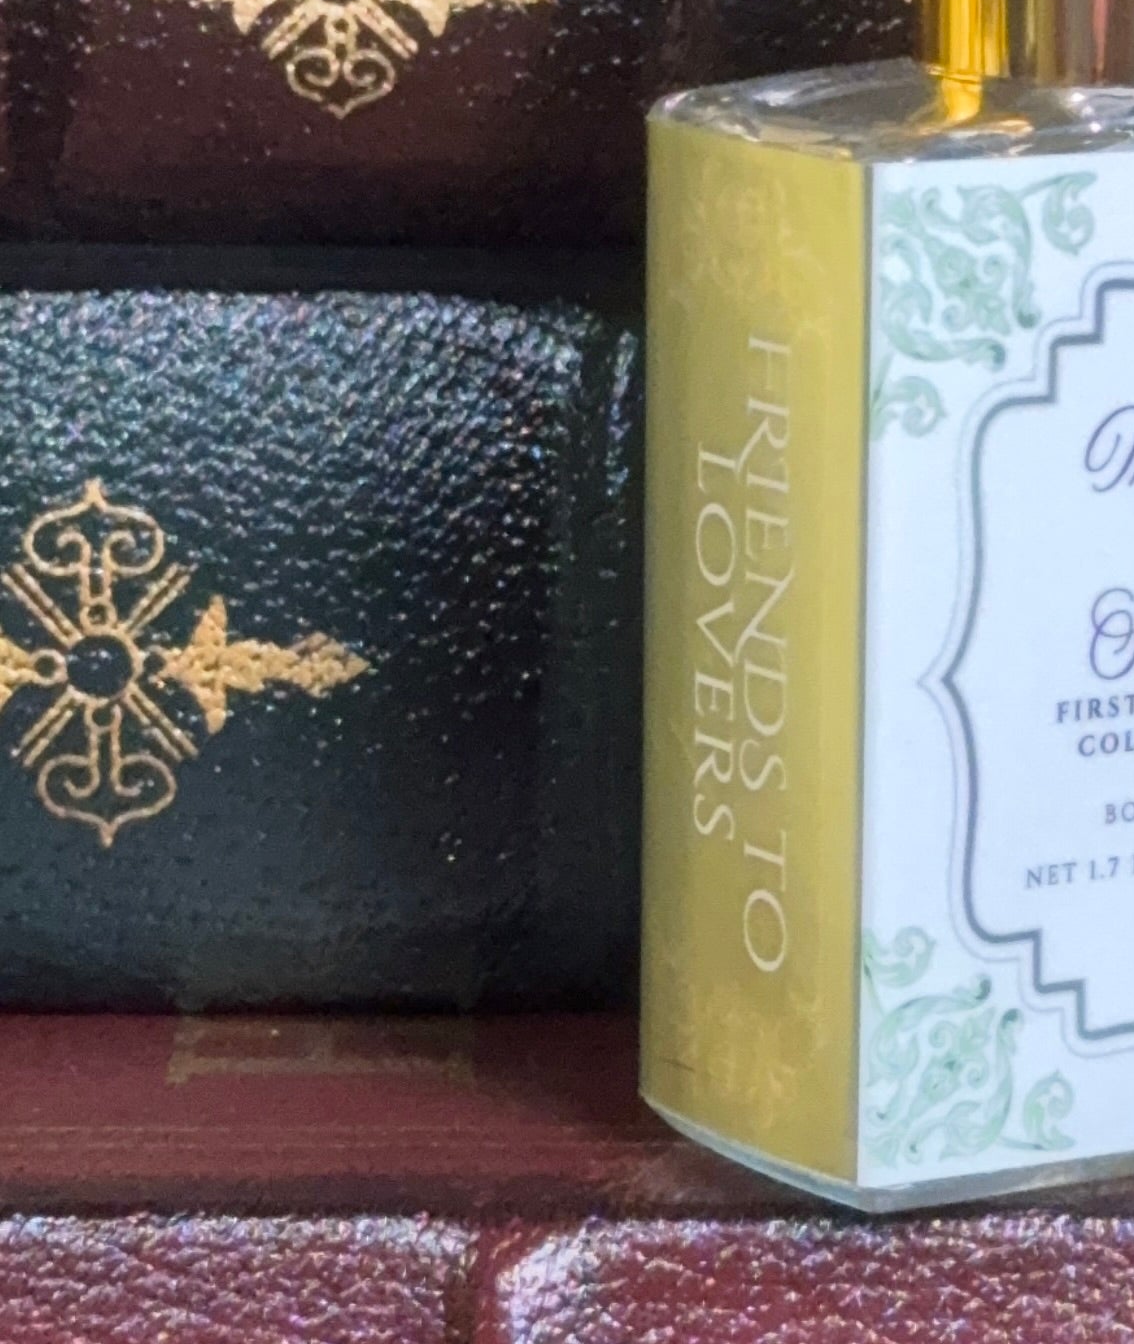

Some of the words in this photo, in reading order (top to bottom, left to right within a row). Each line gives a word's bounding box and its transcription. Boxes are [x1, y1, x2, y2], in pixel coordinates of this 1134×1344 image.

[693, 440, 739, 841] LOVERS
[736, 334, 795, 794] FRIENDS
[742, 829, 789, 973] TO
[1025, 863, 1078, 890] NET
[1088, 857, 1120, 881] 1.7
